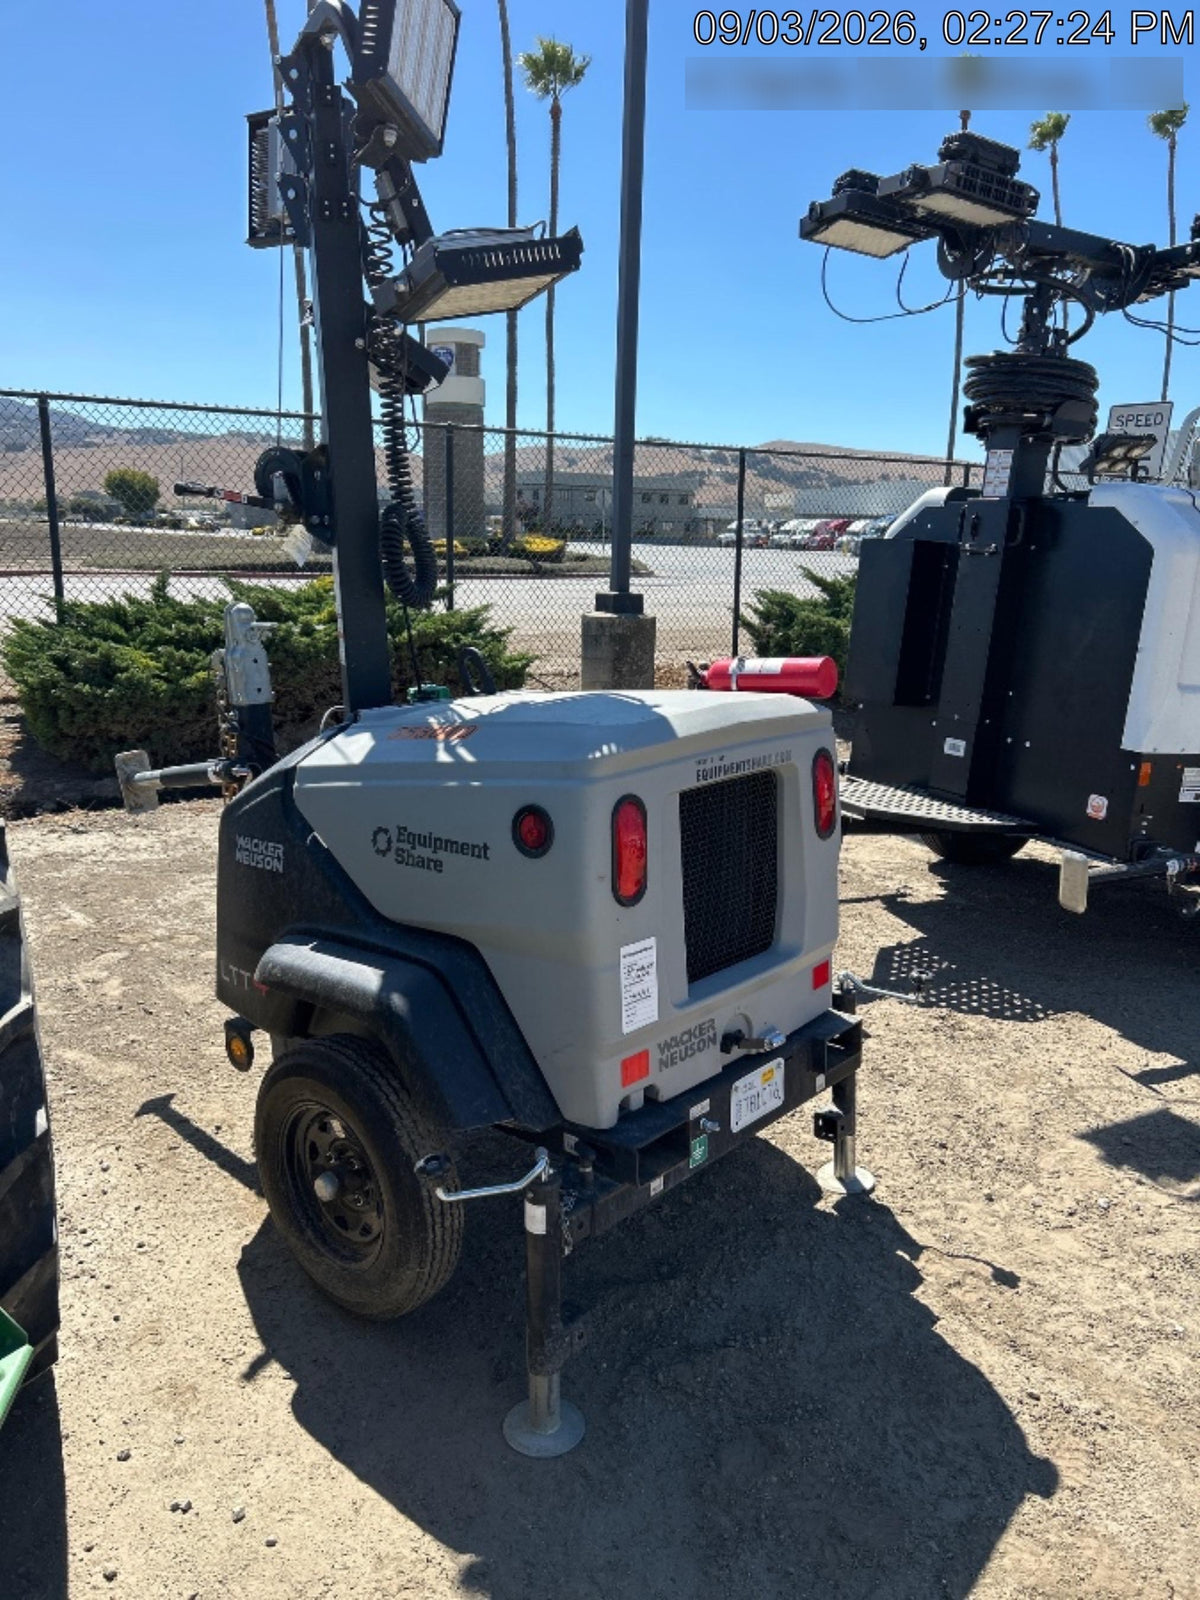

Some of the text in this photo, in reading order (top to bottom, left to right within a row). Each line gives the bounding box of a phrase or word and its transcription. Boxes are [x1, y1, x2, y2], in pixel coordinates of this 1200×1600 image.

[1115, 412, 1164, 428] SPEED
[235, 834, 284, 859] WACKER
[396, 825, 490, 860] Equipment
[235, 848, 284, 873] NEUSON
[395, 846, 444, 873] Share
[656, 1018, 716, 1057] WACKER
[658, 1030, 718, 1073] NEUSON
